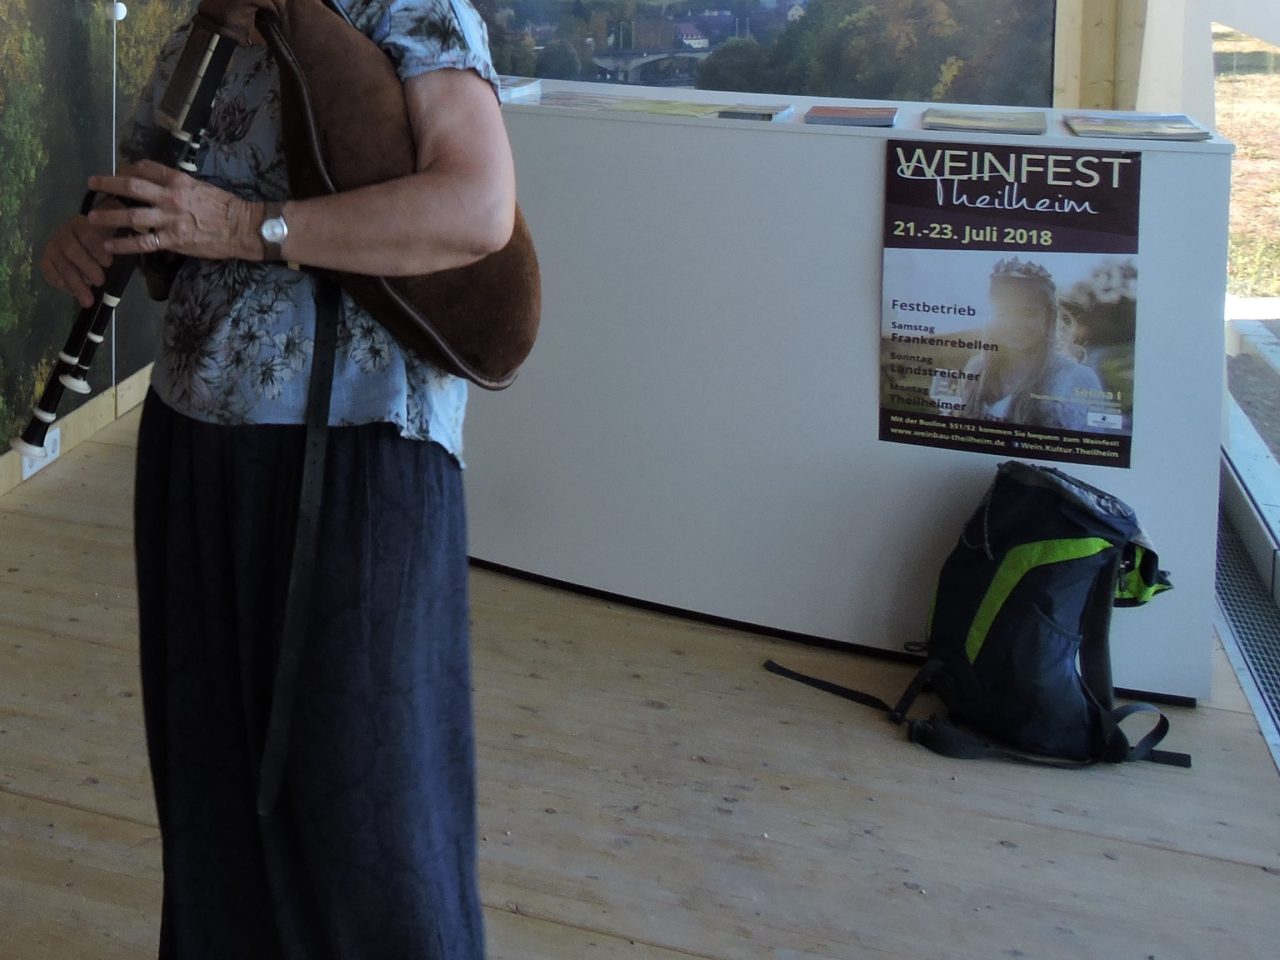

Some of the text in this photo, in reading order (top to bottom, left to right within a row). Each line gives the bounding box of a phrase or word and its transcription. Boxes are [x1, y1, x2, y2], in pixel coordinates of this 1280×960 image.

[895, 146, 1132, 189] WEINFEST
[897, 163, 1100, 214] Theilheim
[893, 220, 1053, 246] 21.-23. Juli 2018
[891, 298, 977, 317] Festbetrieb
[891, 321, 935, 334] Samstag
[890, 333, 999, 352] Frankenrebellen
[889, 351, 933, 365] Sonntag
[889, 364, 981, 382] Landstreicher
[889, 383, 929, 396] Montag
[889, 394, 967, 412] Theilheimer
[890, 427, 1006, 446] www.weinbau-theilheim.de
